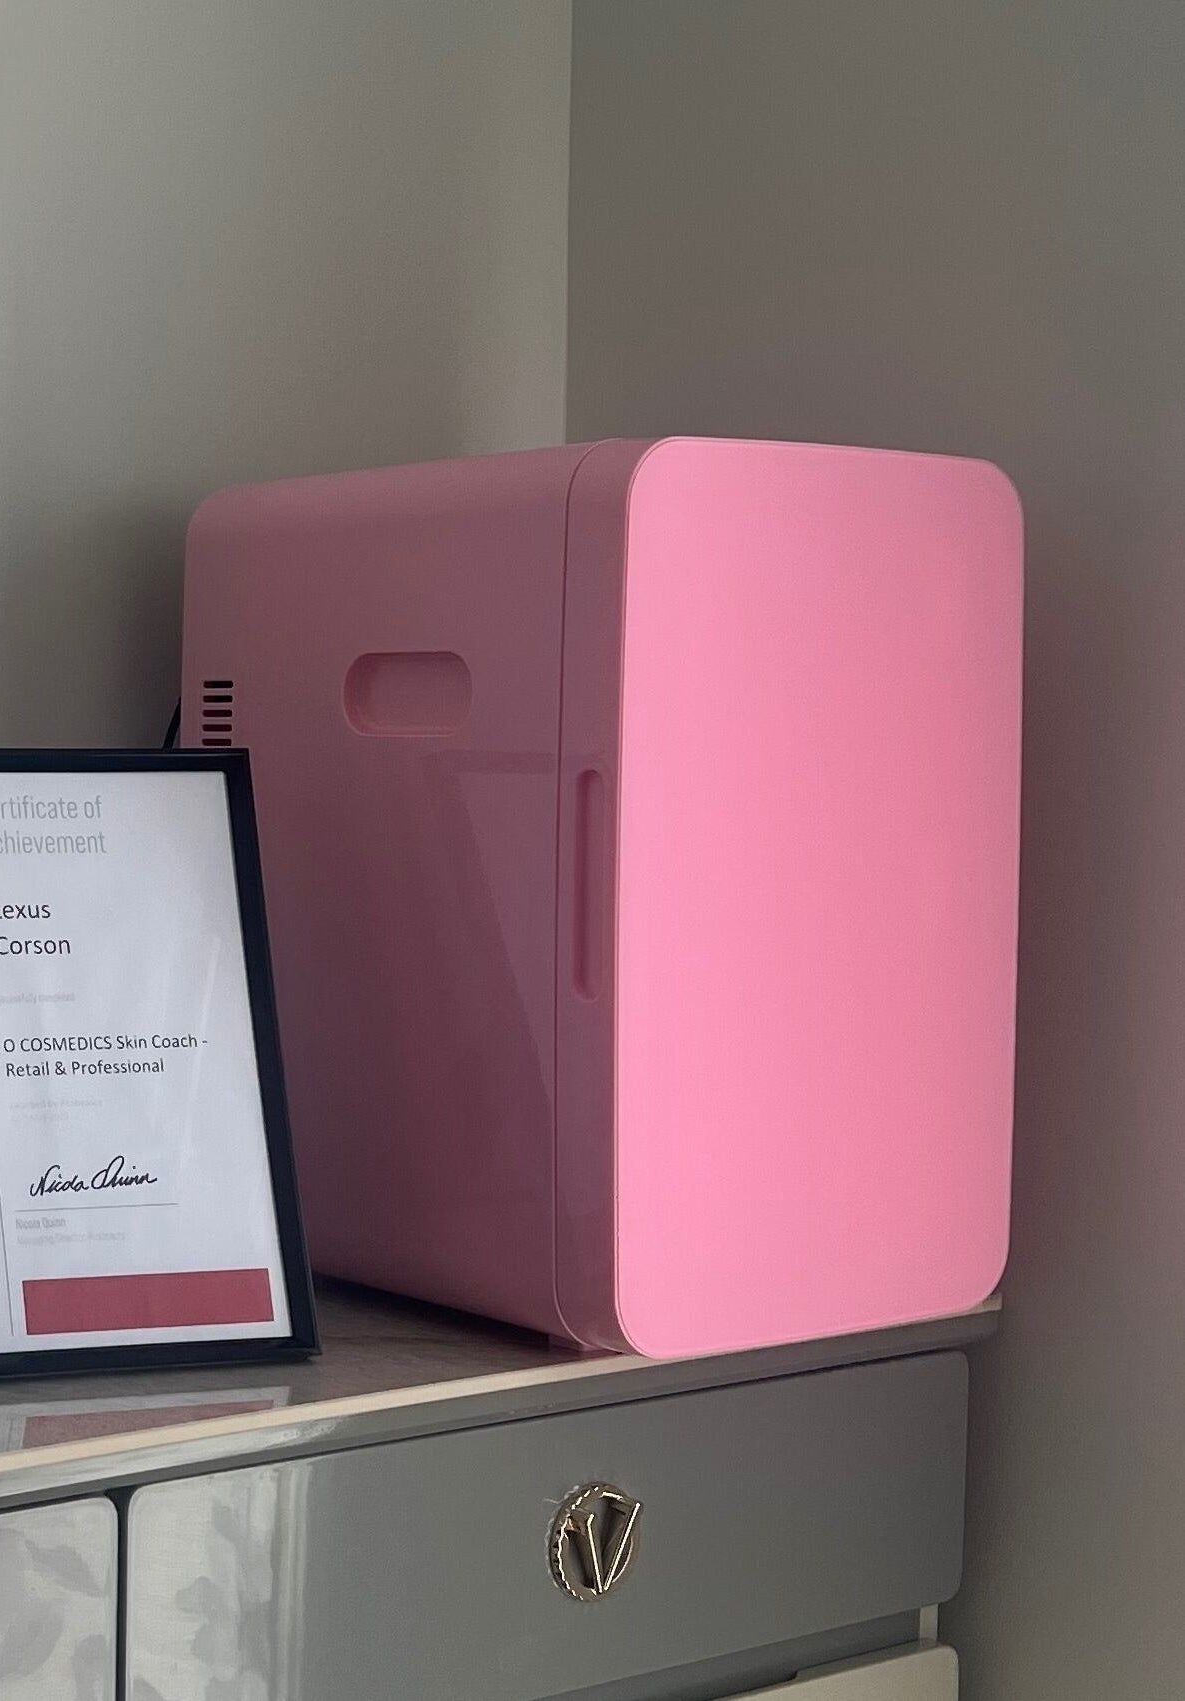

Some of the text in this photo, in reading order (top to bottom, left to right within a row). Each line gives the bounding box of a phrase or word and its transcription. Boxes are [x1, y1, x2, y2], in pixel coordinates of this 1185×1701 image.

[83, 794, 103, 819] of
[3, 1038, 16, 1053] O
[20, 1036, 113, 1053] COSMEDICS
[116, 1034, 148, 1050] Skin
[151, 1033, 198, 1049] Coach
[5, 1057, 165, 1078] Retail & Professional
